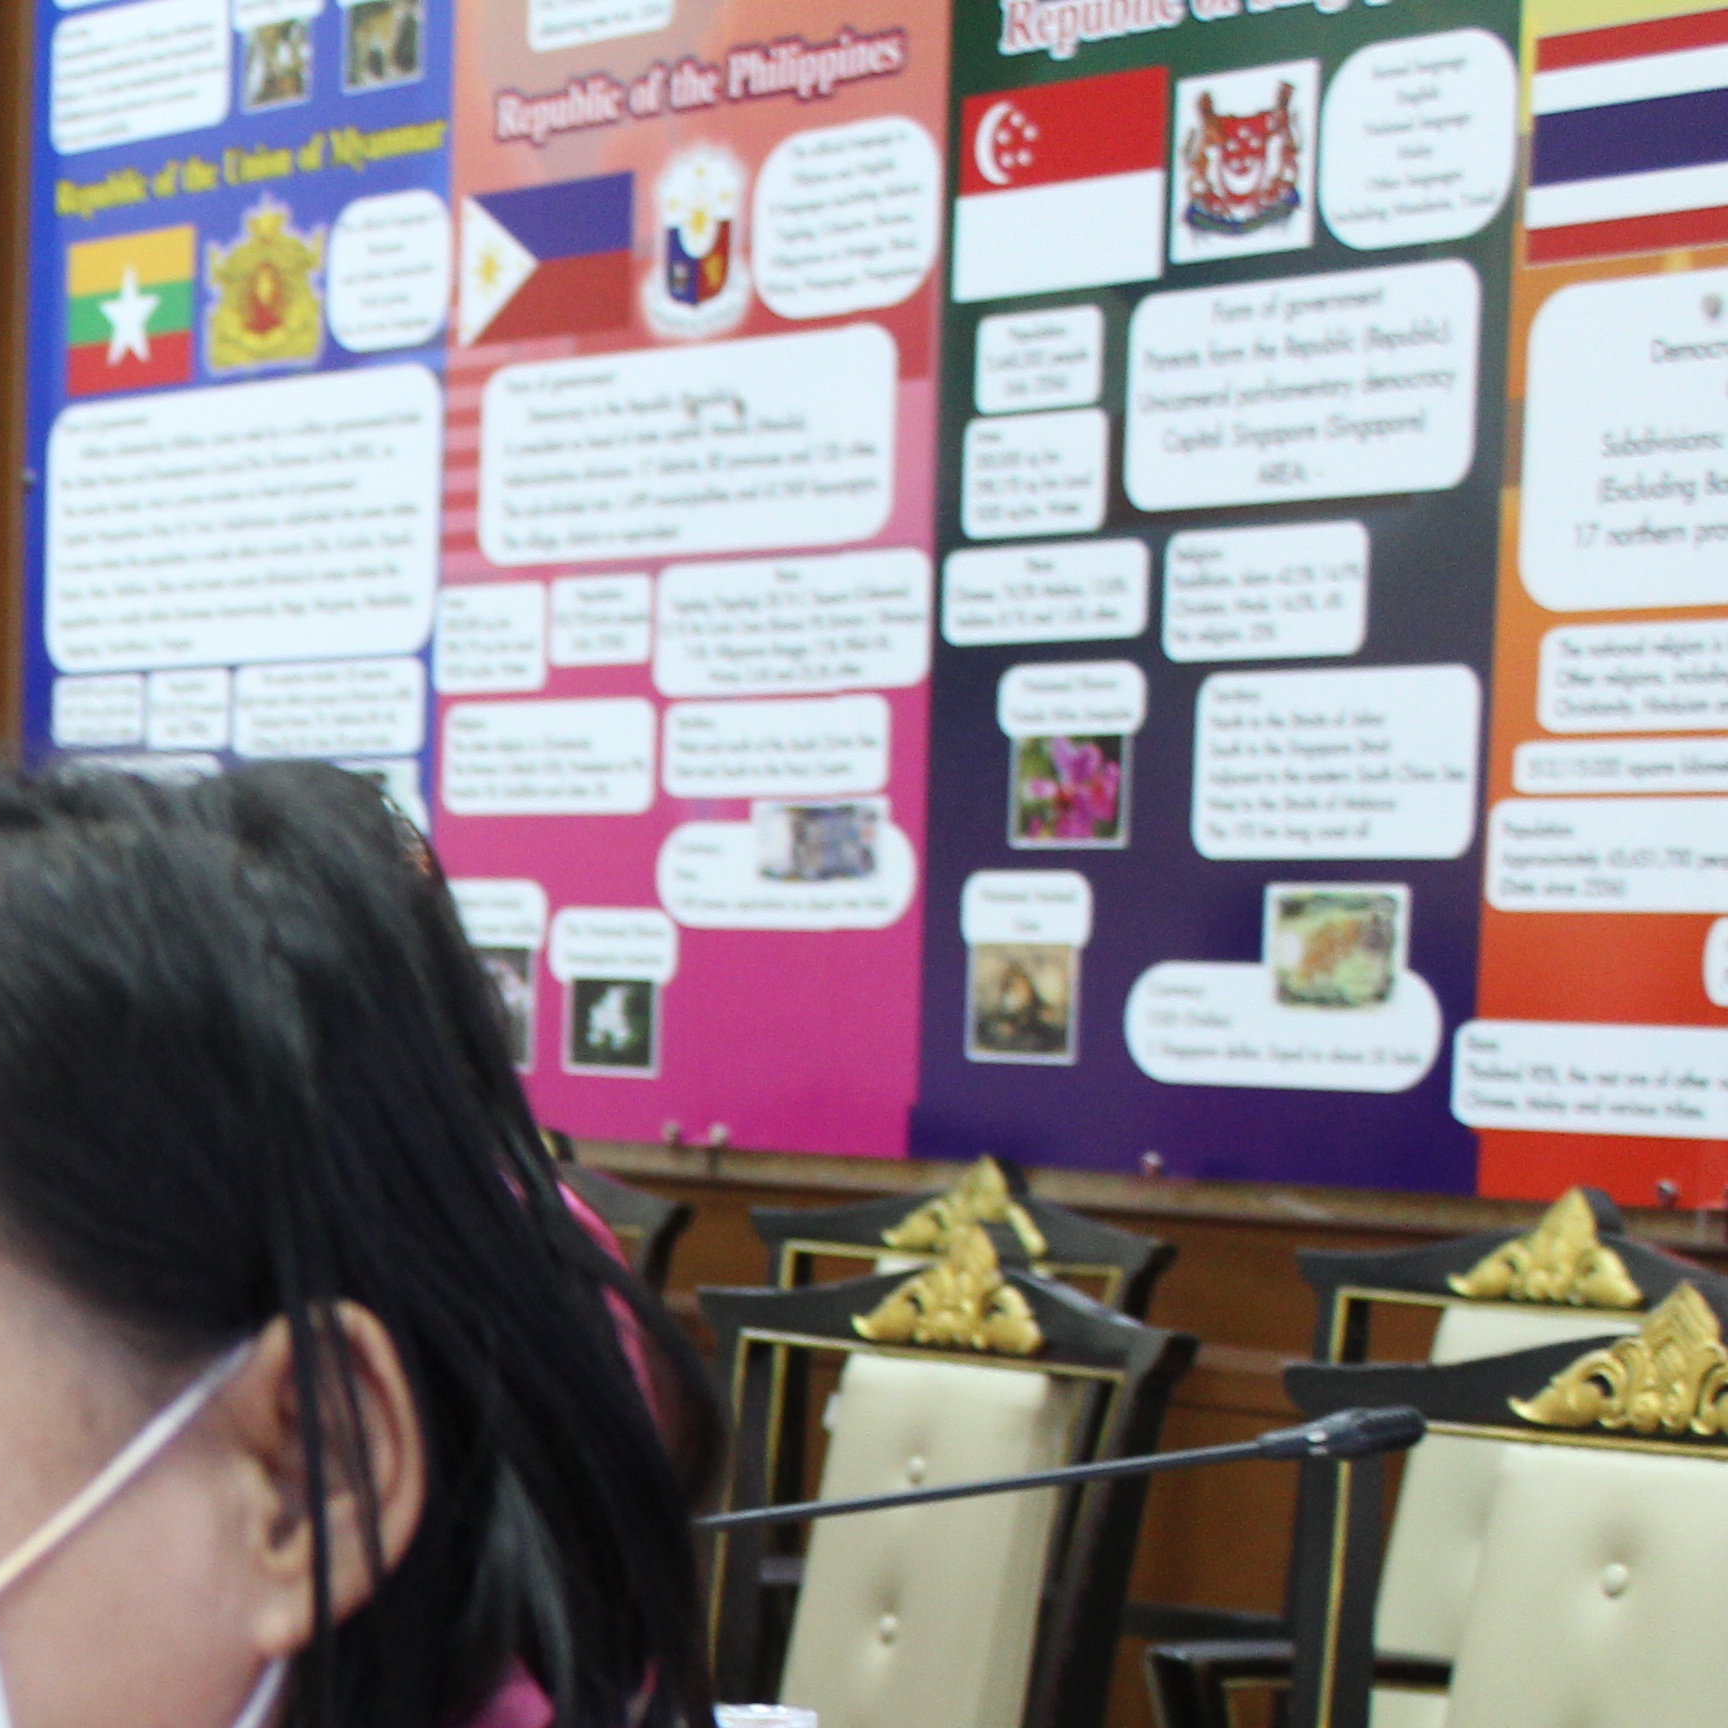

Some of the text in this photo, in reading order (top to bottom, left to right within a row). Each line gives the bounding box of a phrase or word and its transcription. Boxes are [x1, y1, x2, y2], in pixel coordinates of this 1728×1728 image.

[497, 29, 905, 142] Republic of the Philippines
[54, 168, 147, 219] Republic
[151, 160, 178, 198] of
[181, 156, 218, 193] the
[223, 143, 293, 185] Union
[297, 132, 325, 172] of
